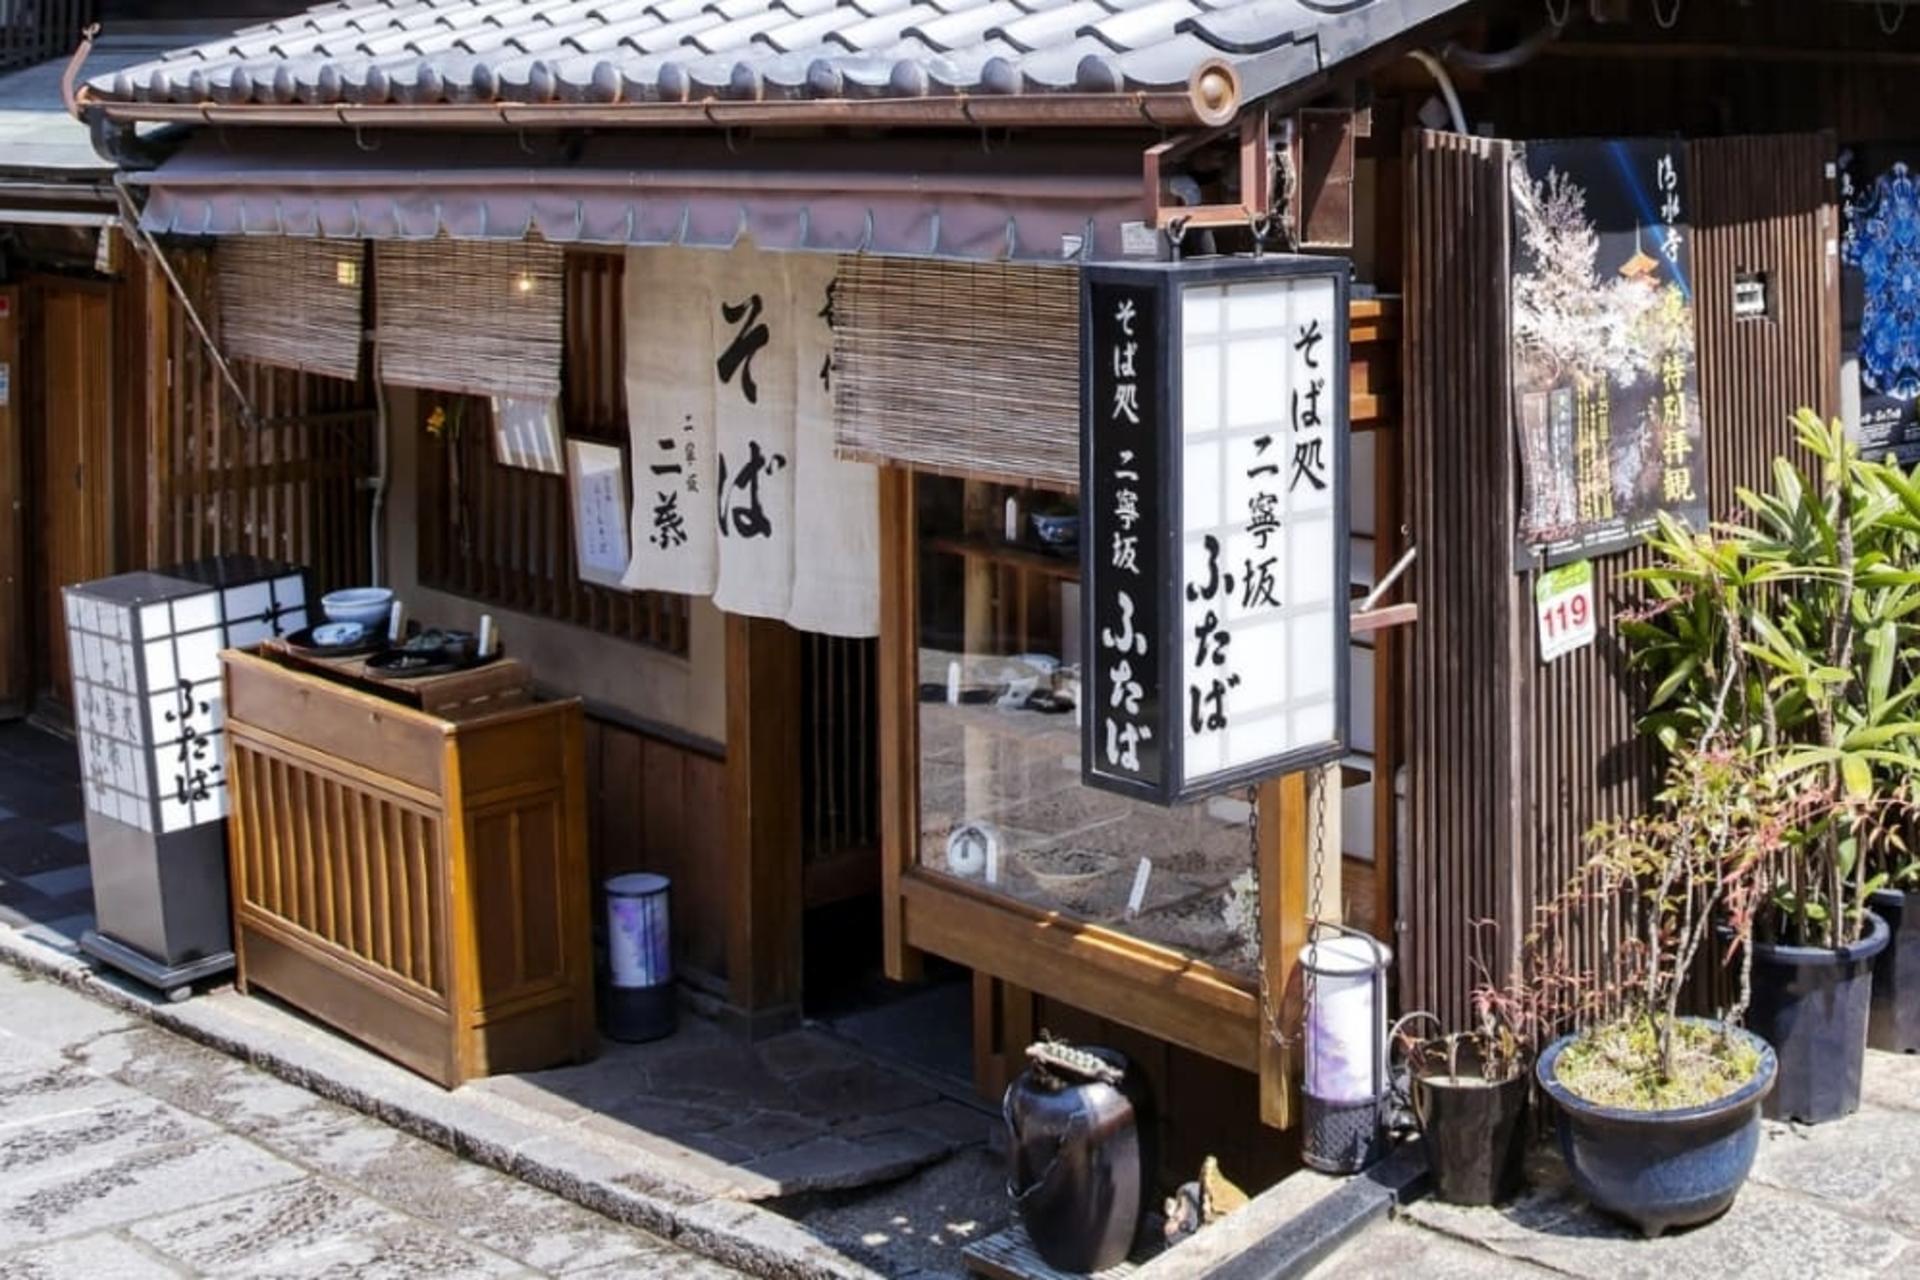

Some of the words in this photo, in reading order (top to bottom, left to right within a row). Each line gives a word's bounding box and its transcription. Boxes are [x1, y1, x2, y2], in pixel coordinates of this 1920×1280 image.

[716, 294, 787, 539] そば
[1112, 299, 1140, 425] そば処
[1288, 319, 1327, 492] そば処
[1111, 449, 1141, 576] 二寧坂
[1241, 435, 1282, 609] 二寧坂
[1101, 591, 1153, 773] ふたば
[1186, 534, 1241, 735] ふたば
[1543, 594, 1586, 638] 119
[164, 679, 222, 805] ふたば
